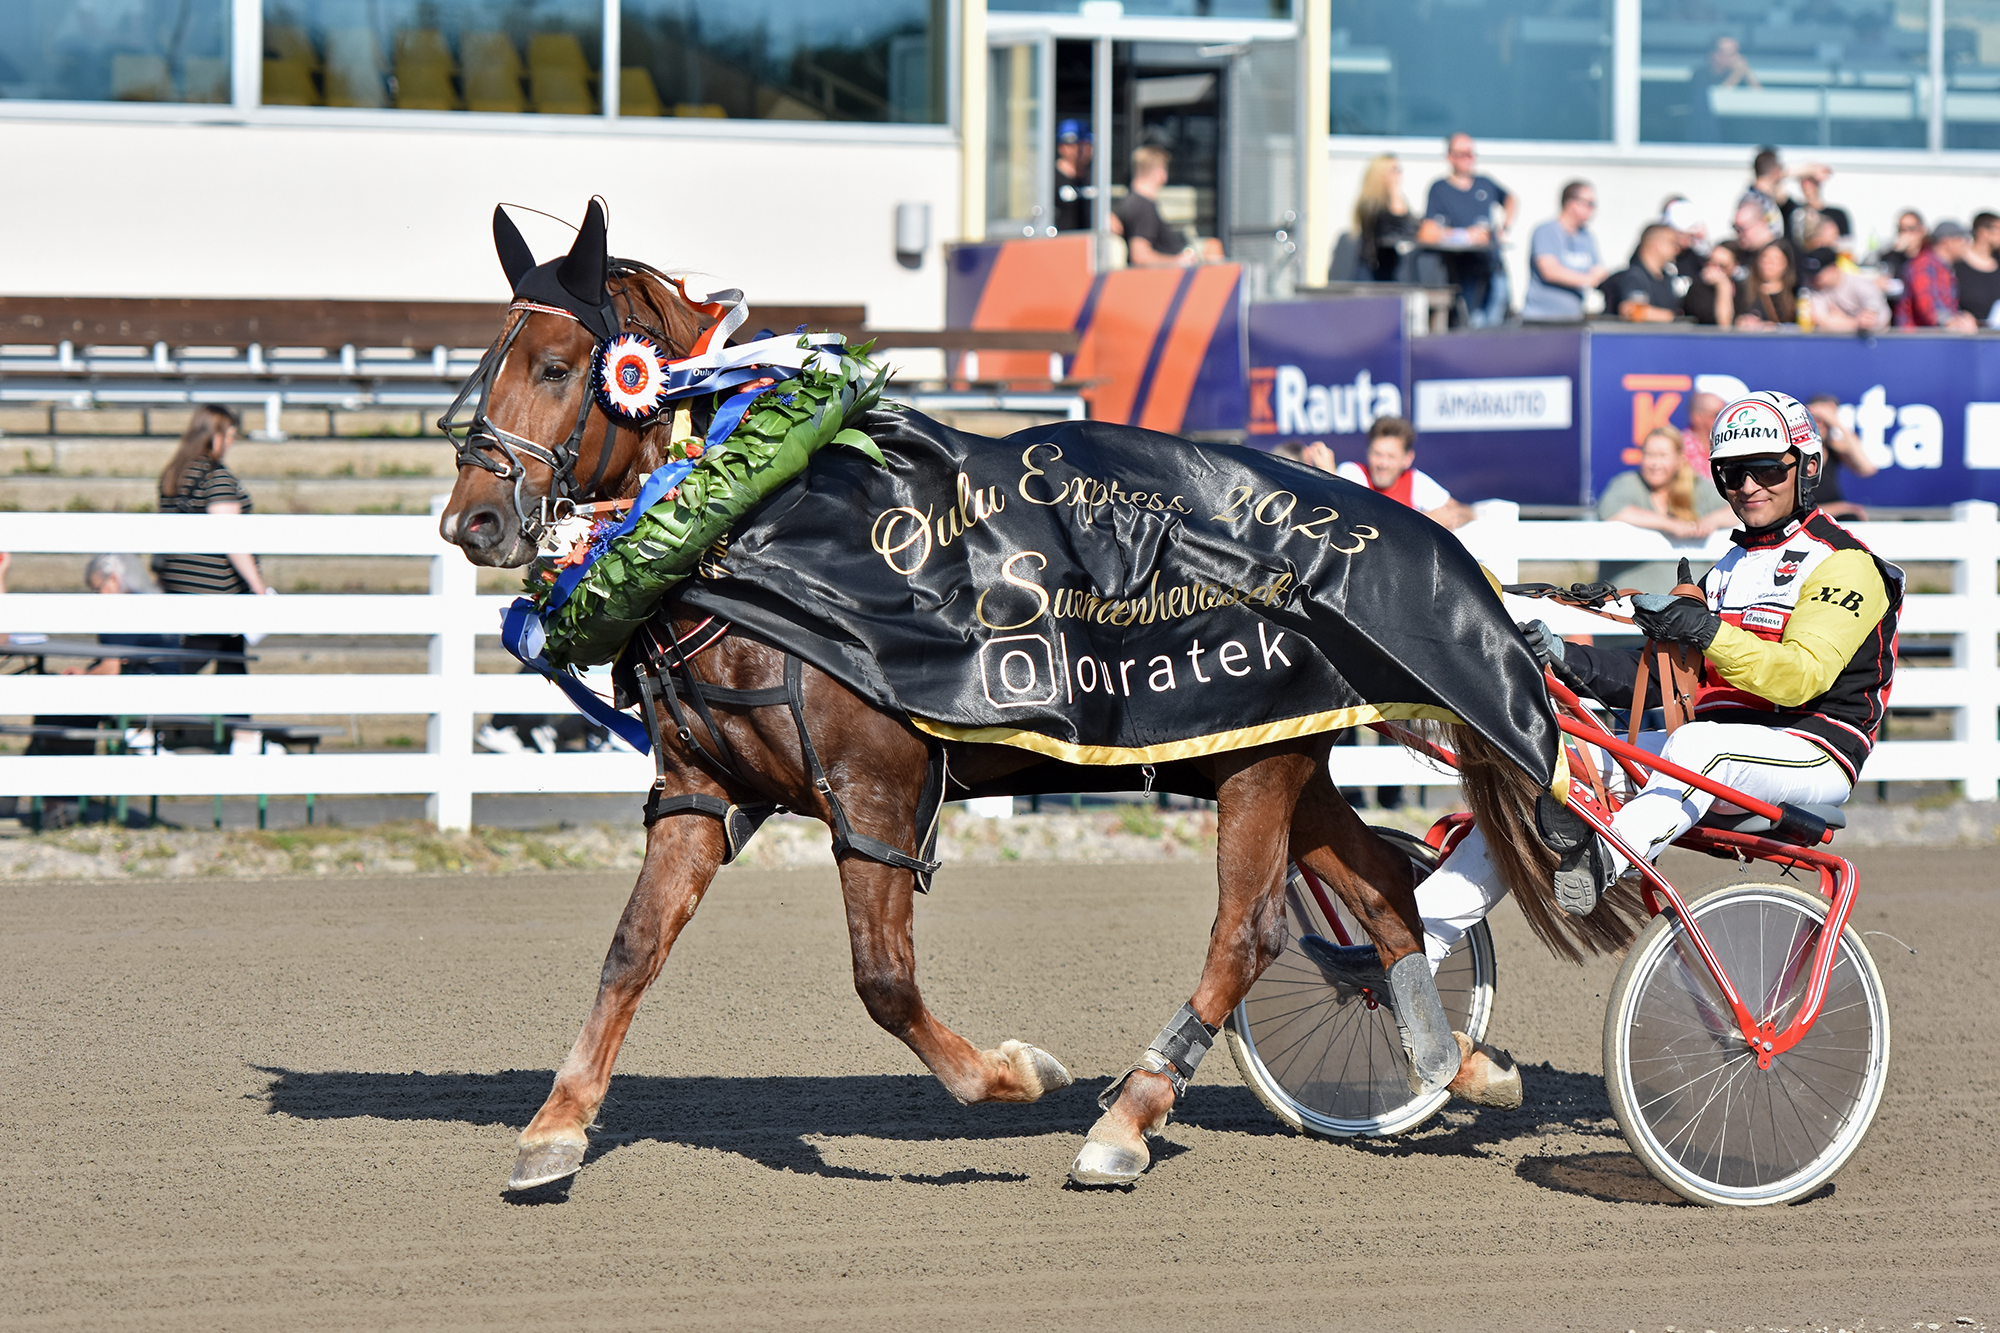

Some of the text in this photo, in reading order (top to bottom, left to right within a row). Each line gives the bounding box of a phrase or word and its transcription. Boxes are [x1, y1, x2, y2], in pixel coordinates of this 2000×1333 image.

[1277, 365, 1403, 435] Rauta
[1714, 427, 1778, 446] BIOFARM
[871, 443, 1380, 576] Oulu Express 2023
